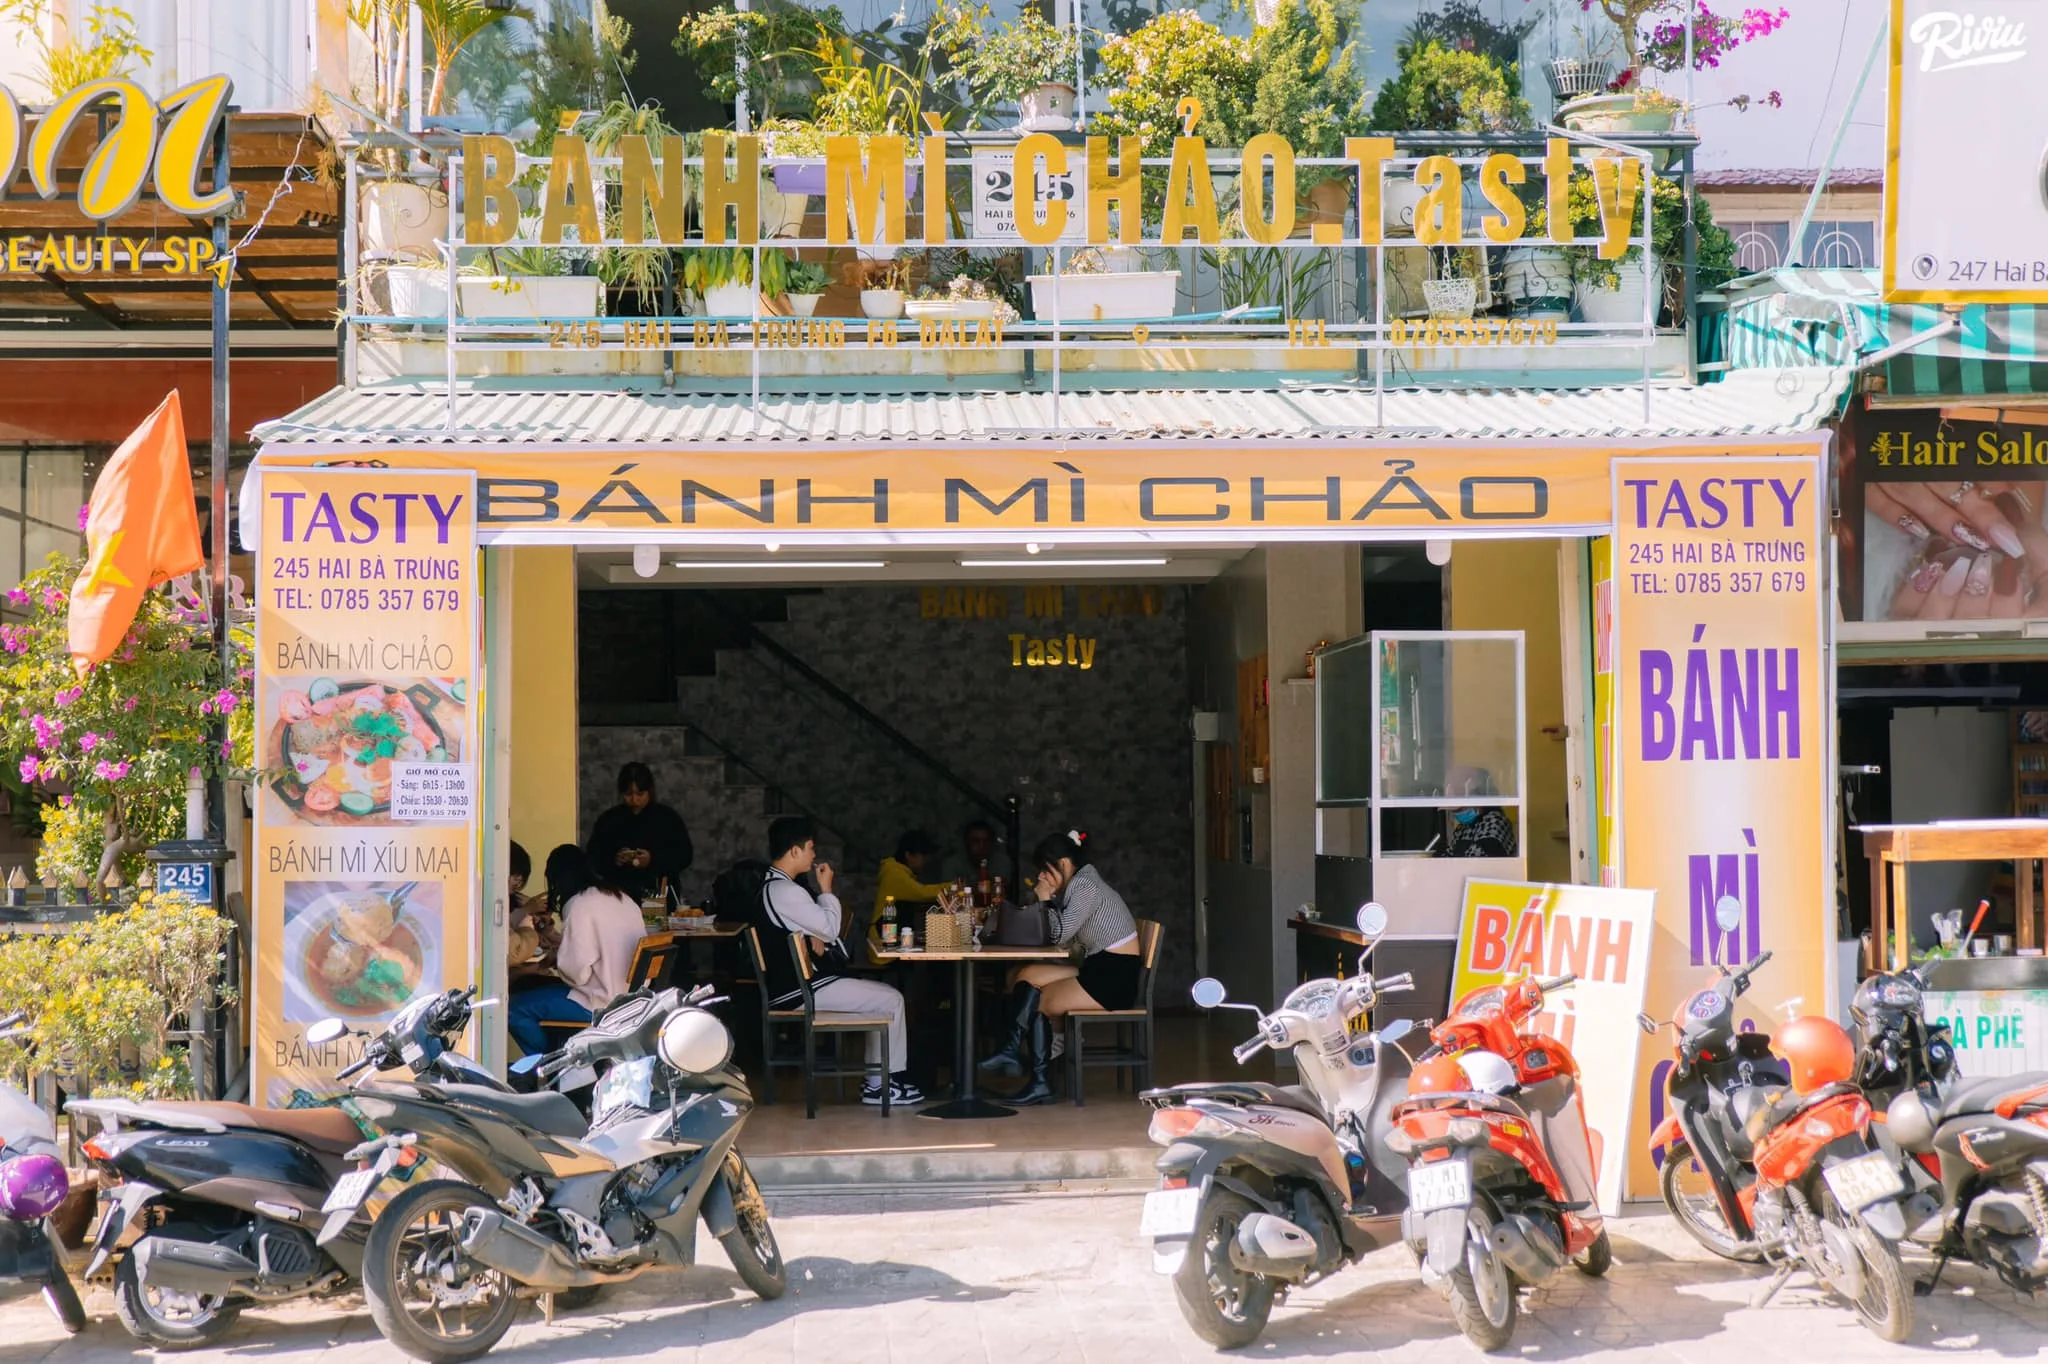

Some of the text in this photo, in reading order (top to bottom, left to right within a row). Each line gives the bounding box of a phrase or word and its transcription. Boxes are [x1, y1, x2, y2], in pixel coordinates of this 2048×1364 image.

[462, 111, 759, 244] BÁNH
[825, 110, 948, 244] MÌ
[984, 210, 1004, 219] HAI
[0, 233, 151, 273] EAUTY
[1949, 261, 1987, 281] 247
[1994, 262, 2027, 282] Hai
[549, 319, 601, 349] 245
[624, 319, 672, 349] HAI
[1286, 318, 1557, 348] TEL 0785357679
[1870, 431, 1966, 466] Hair
[475, 458, 1549, 524] BÁNH MÌ CHẢO
[1623, 478, 1807, 529] TASTY
[270, 491, 464, 544] TASTY
[273, 554, 460, 581] 245 HAI BÀ TRƯNG
[1629, 538, 1805, 564] 245 HAI BÀ TRƯNG
[274, 588, 459, 611] TEL: 0785 357 679
[1630, 572, 1806, 594] TEL: 0785 357 679
[278, 635, 453, 671] BÁNH MÌ CHẢO
[1008, 633, 1096, 670] Tasty
[1639, 623, 1801, 762] BÁNH
[164, 867, 205, 886] 245
[269, 840, 458, 879] BÁNH MÌ XÍU MẠI
[1689, 828, 1761, 966] MÌ
[1472, 897, 1633, 984] BÁNH
[275, 1035, 340, 1067] BÁNH
